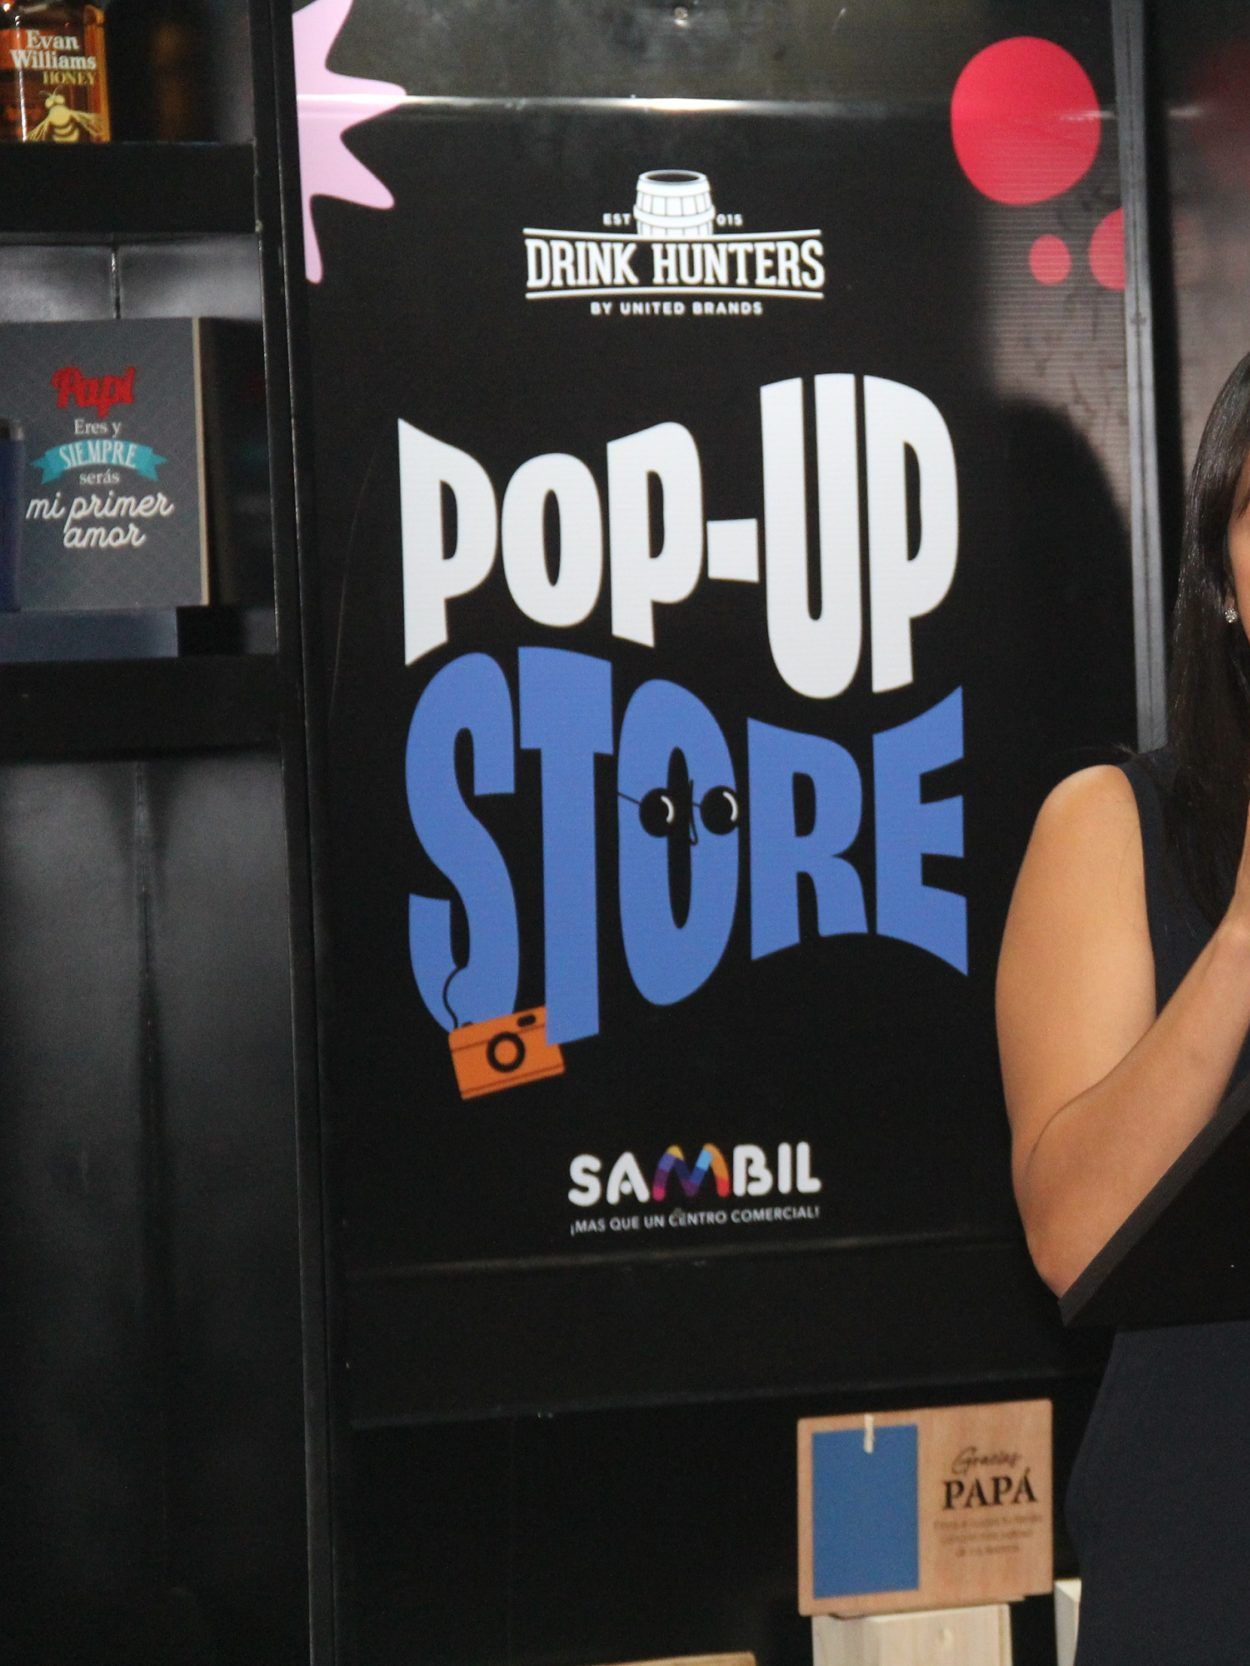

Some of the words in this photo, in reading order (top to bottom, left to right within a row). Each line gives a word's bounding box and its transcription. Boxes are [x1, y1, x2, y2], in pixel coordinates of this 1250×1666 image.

[26, 29, 79, 50] Evan
[9, 48, 97, 70] Williams
[43, 70, 95, 86] HONEY
[602, 212, 631, 226] EST
[524, 238, 639, 288] DRINK
[652, 239, 825, 288] HUNTERS
[591, 302, 612, 315] BY
[620, 302, 685, 315] UNITED
[692, 302, 763, 315] BRANDS
[73, 419, 108, 436] Eres
[110, 421, 122, 440] y
[58, 439, 138, 470] SIEMPRE
[79, 469, 120, 485] serás
[26, 492, 65, 520] mi
[63, 491, 175, 534] primer
[63, 523, 147, 549] amor
[397, 372, 960, 700] POP-UP
[404, 645, 970, 1046] STORE
[567, 1141, 822, 1207] SAMBIL
[609, 1215, 640, 1232] QUE
[643, 1213, 665, 1230] UN
[668, 1210, 728, 1227] CENTRO
[730, 1205, 820, 1224] COMERCIAL!
[941, 1467, 1040, 1510] PAPÁ
